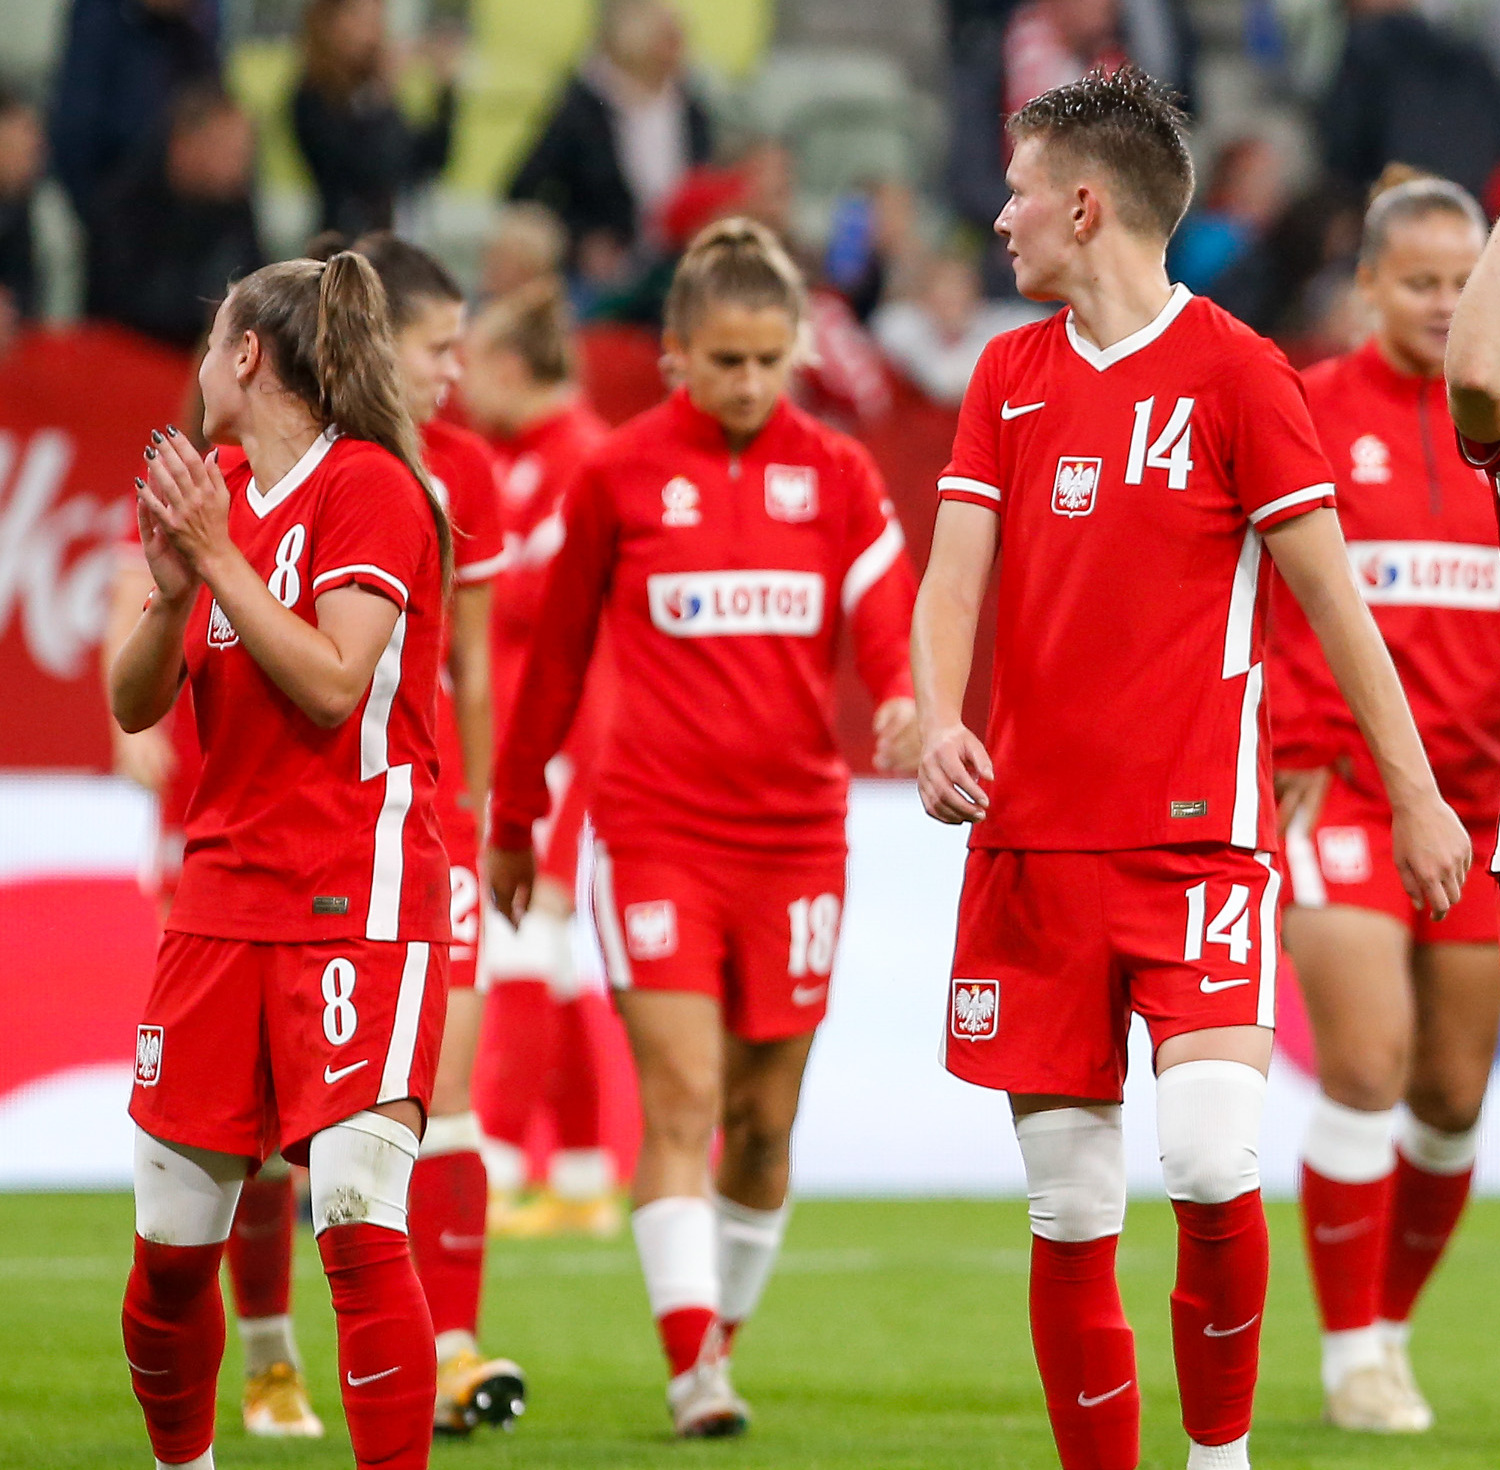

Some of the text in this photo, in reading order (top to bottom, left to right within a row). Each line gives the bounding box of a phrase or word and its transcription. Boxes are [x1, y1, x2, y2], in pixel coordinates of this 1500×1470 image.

[1124, 395, 1195, 490] 14
[271, 523, 305, 607] 8
[711, 585, 810, 619] LOTOS
[1410, 556, 1497, 592] LOTOS
[786, 892, 841, 978] 18
[1183, 880, 1253, 965] 14
[321, 957, 358, 1046] 8
